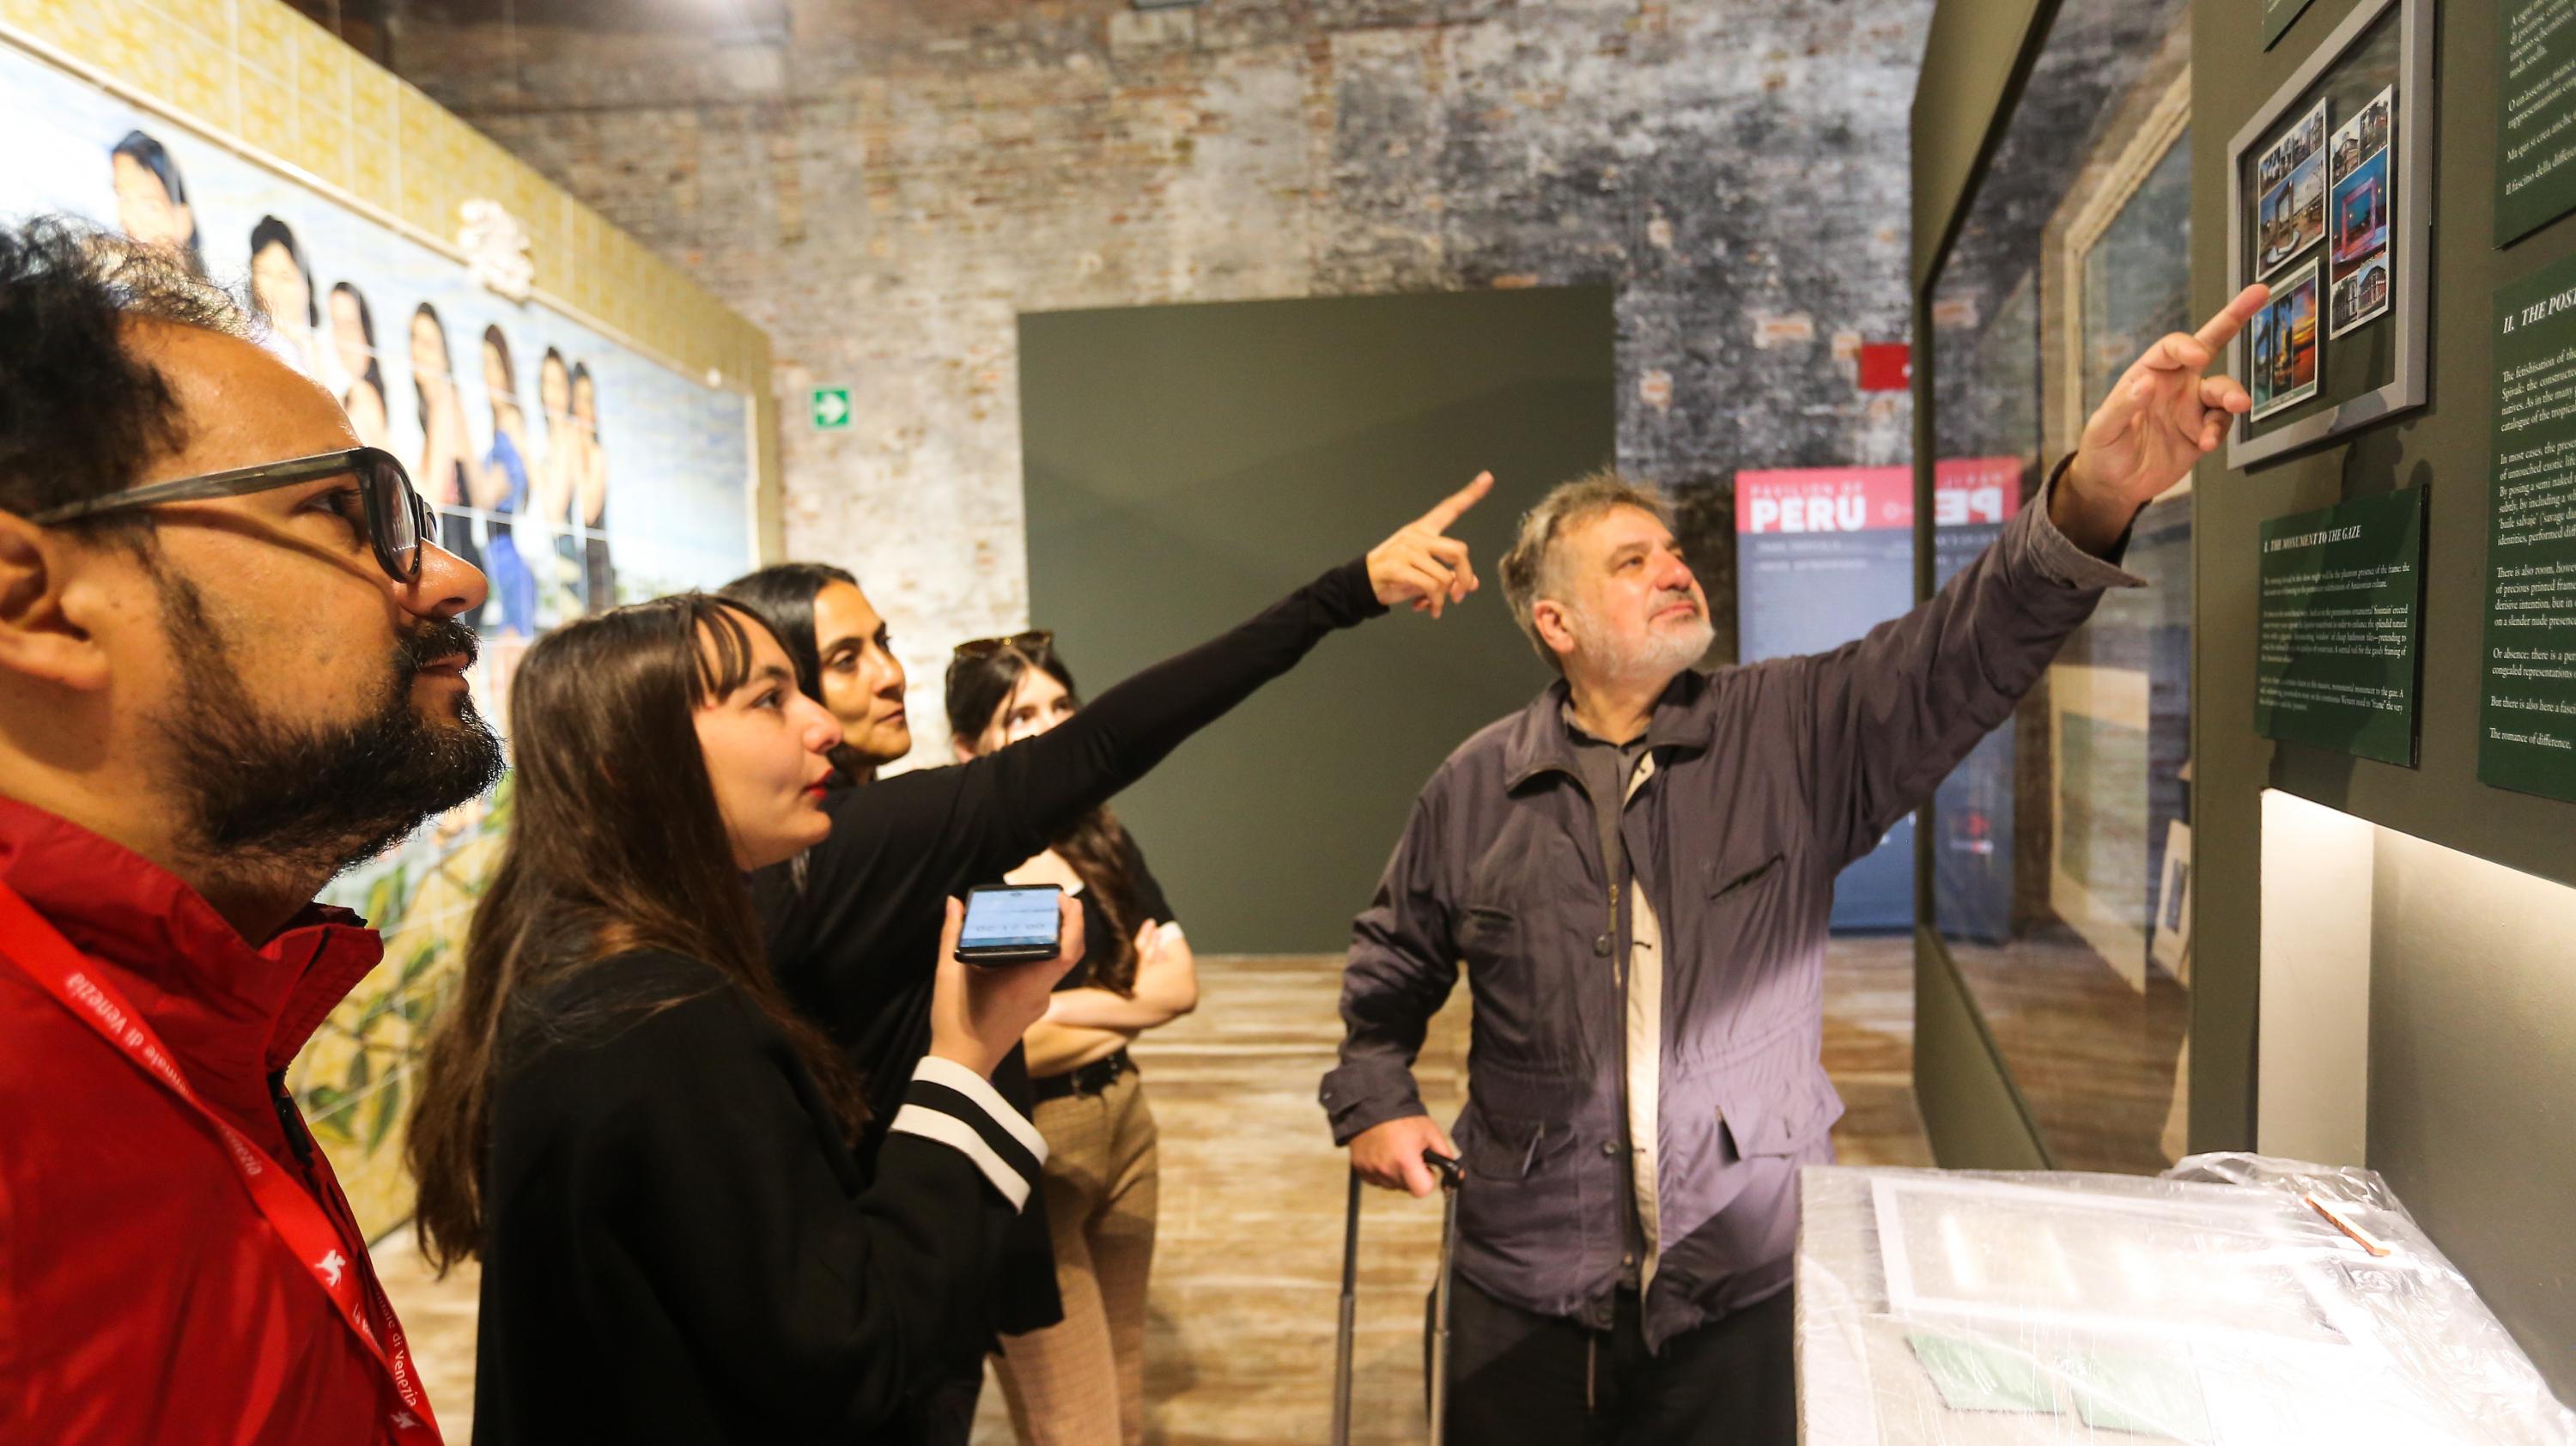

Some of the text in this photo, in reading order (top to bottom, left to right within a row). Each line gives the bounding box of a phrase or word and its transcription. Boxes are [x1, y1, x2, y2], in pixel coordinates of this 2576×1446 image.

[2502, 315, 2515, 335] II.
[2520, 301, 2547, 327] THE
[2501, 370, 2514, 383] The
[2556, 349, 2566, 364] of
[2526, 379, 2538, 392] the
[2525, 397, 2534, 409] As
[2534, 398, 2542, 406] in
[2542, 390, 2554, 404] the
[2554, 386, 2573, 400] many
[2500, 417, 2530, 432] catalogue
[2530, 410, 2539, 424] of
[2539, 409, 2551, 422] the
[2500, 453, 2508, 465] In
[2508, 452, 2524, 463] most
[2544, 440, 2556, 454] the
[2500, 468, 2508, 482] of
[2508, 460, 2542, 479] untouched
[2542, 459, 2564, 472] exotic
[2499, 486, 2508, 500] By
[2508, 483, 2530, 499] posing
[2535, 477, 2551, 490] semi
[2552, 471, 2573, 488] naked
[2519, 498, 2528, 513] by
[2528, 494, 2561, 509] including
[1750, 495, 1867, 534] PERU
[2282, 532, 2318, 550] MONUMENT
[2318, 531, 2328, 545] TO
[2328, 528, 2342, 544] THE
[2342, 525, 2361, 541] GAZE
[2528, 526, 2563, 546] performed
[2496, 566, 2514, 579] There
[2514, 566, 2521, 577] is
[2521, 563, 2534, 576] also
[2495, 582, 2505, 595] of
[2504, 583, 2530, 597] precious
[2530, 579, 2555, 595] printed
[2392, 603, 2409, 615] erected
[2552, 596, 2565, 609] but
[2565, 598, 2573, 609] in
[2494, 617, 2503, 628] on
[2508, 614, 2530, 627] slender
[2530, 613, 2548, 627] nude
[2493, 647, 2502, 659] Or
[2530, 647, 2549, 660] there
[2549, 649, 2556, 661] is
[2492, 664, 2573, 681] congealed representations
[2491, 696, 2502, 708] But
[2502, 696, 2518, 708] there
[2519, 699, 2525, 709] is
[2525, 698, 2538, 711] also
[2539, 699, 2555, 713] here
[2489, 726, 2572, 750] The romance of difference.
[65, 971, 128, 1036] Venezia
[392, 1332, 405, 1348] di
[394, 1348, 418, 1408] Venezia
